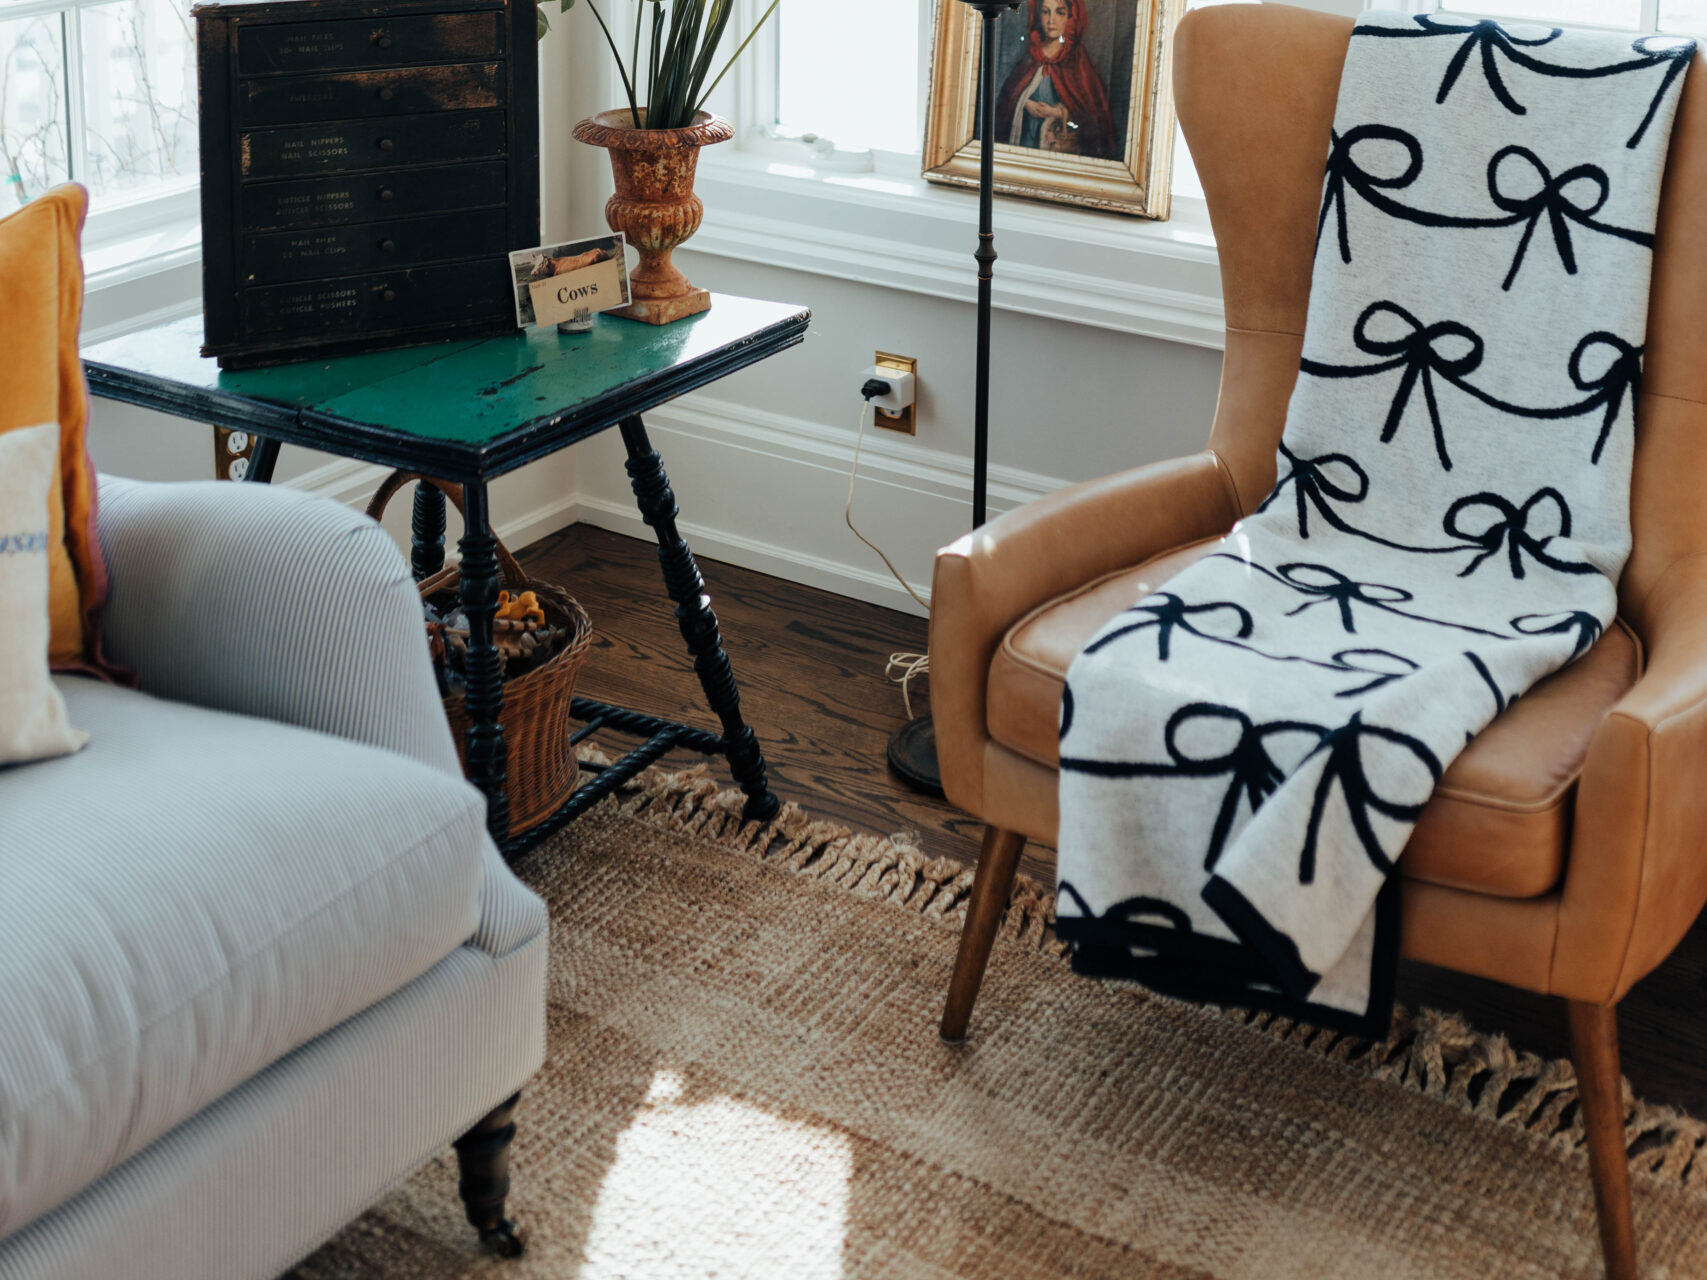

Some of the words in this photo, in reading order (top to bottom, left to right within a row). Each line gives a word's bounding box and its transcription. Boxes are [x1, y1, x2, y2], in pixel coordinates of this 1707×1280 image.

[284, 140, 304, 148] NAIL
[311, 136, 345, 146] NIPPERS
[281, 151, 302, 160] NAIL
[307, 147, 349, 158] SCISSORS
[277, 194, 311, 205] CUTICLE
[316, 191, 350, 201] NIPPERS
[315, 202, 354, 212] SCISSORS
[317, 289, 356, 300] SCISSORS
[557, 282, 599, 304] Cows
[320, 299, 356, 309] PUSHERS
